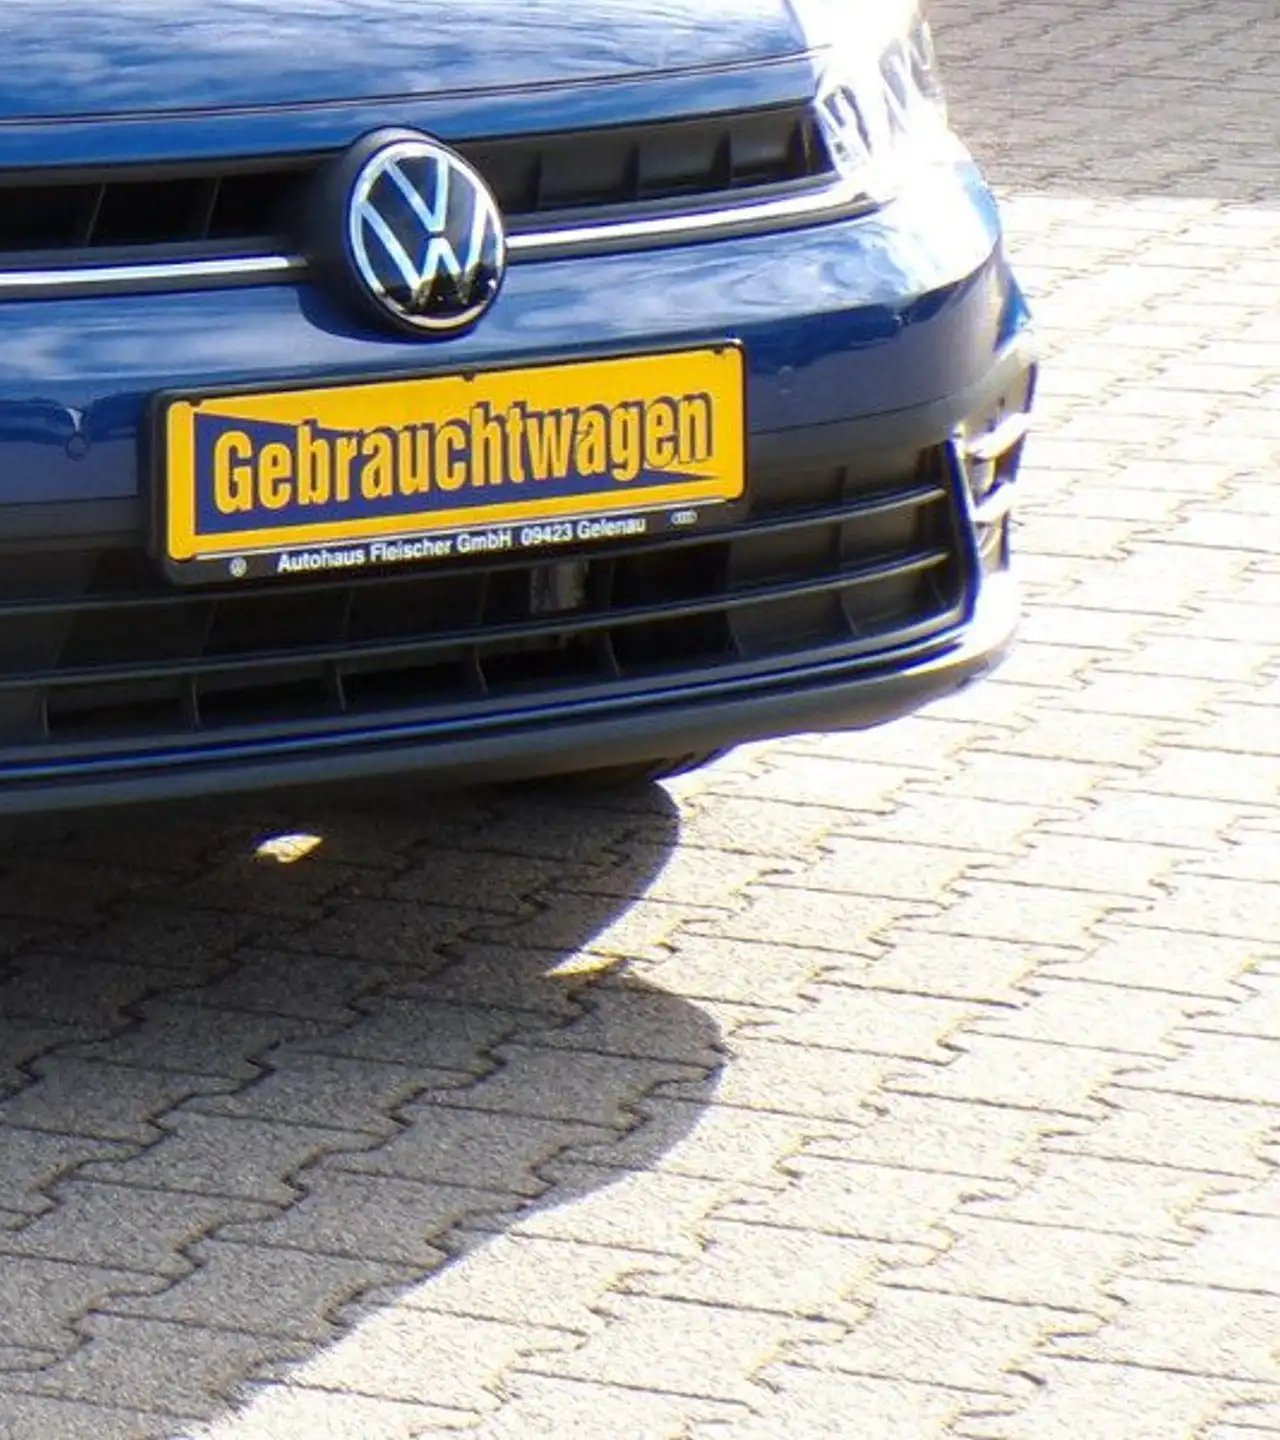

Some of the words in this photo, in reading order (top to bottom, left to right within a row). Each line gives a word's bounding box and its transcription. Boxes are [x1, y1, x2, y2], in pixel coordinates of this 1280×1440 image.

[213, 392, 714, 515] Gebrauchtwagen
[276, 549, 366, 573] Autohaus
[369, 537, 453, 561] Fleischer
[456, 529, 512, 553] GmbH
[520, 522, 573, 546] 09423
[576, 517, 647, 540] Gelenau
